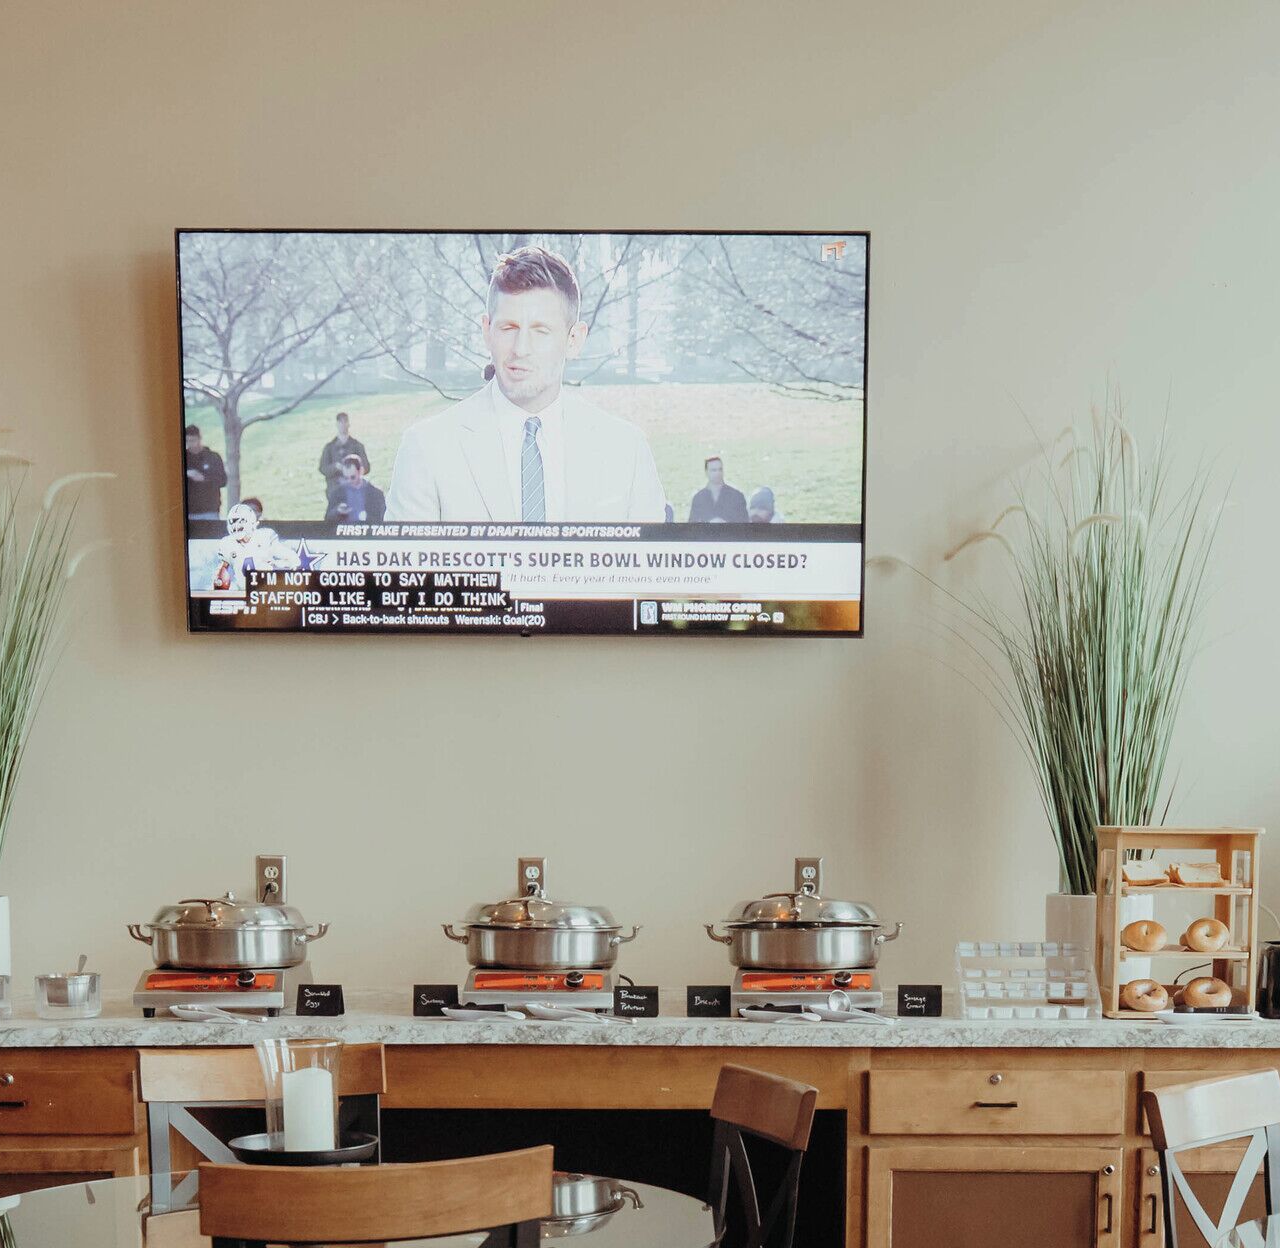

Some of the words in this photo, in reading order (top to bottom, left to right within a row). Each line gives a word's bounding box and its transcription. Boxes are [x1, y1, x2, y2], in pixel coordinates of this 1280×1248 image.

[336, 525, 369, 536] FIRST
[371, 525, 400, 537] TAKE
[401, 525, 469, 537] PRESENTED
[470, 525, 486, 537] BY
[487, 525, 559, 537] DRAFTKINGS
[561, 526, 641, 538] SPORTSBOOK
[336, 551, 371, 566] HAS
[376, 551, 413, 567] DAK
[418, 551, 523, 567] PRESCOTT'S
[528, 552, 585, 568] SUPER
[590, 552, 641, 568] BOWL
[647, 553, 726, 568] WINDOW
[732, 553, 808, 569] CLOSED?
[250, 572, 277, 586] I'M
[285, 572, 312, 586] NOT
[320, 572, 365, 586] GOING
[373, 572, 392, 586] TO
[399, 573, 426, 587] SAY
[434, 573, 498, 587] MATTHEW
[656, 576, 680, 584] even
[250, 591, 321, 605] STAFFORD
[329, 592, 371, 607] LIKE,
[382, 592, 409, 606] BUT
[418, 592, 426, 605] I
[435, 592, 454, 606] DO
[461, 592, 507, 606] THINK
[521, 602, 544, 612] Final
[308, 614, 328, 624] CBJ
[343, 614, 406, 625] Back-to-back
[407, 614, 450, 625] shutouts
[503, 615, 546, 627] Goal(20)
